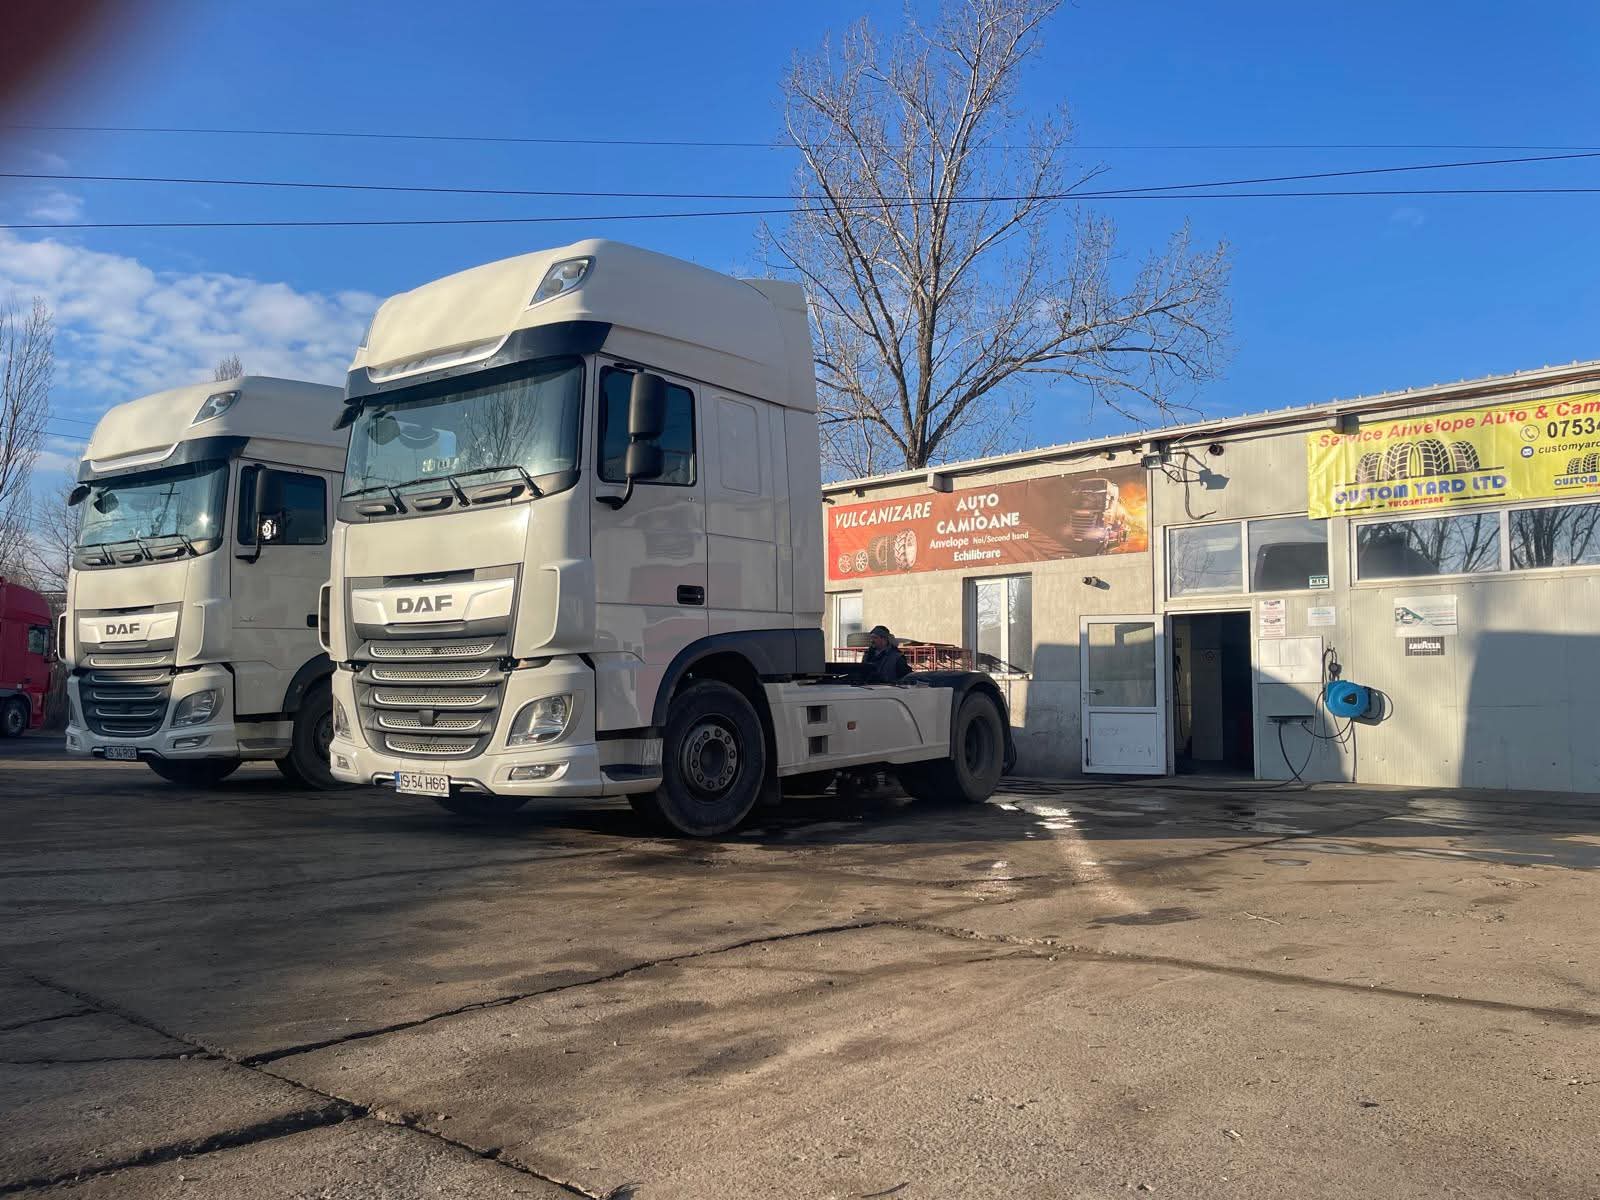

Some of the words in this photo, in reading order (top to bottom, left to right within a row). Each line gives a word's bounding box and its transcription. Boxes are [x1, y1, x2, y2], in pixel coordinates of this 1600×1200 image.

[1388, 417, 1475, 438] Anvelope
[1481, 409, 1527, 426] Auto
[1535, 405, 1548, 419] &
[1414, 479, 1466, 495] YARD
[1472, 475, 1508, 490] LTD
[956, 493, 999, 512] AUTO
[834, 501, 932, 529] VULCANIZARE
[936, 512, 1020, 534] CAMIOANE
[929, 536, 969, 549] Anvelope
[1012, 531, 1029, 541] hand
[953, 549, 1001, 562] Echilibrare
[396, 594, 453, 614] DAF
[105, 622, 140, 635] DAF
[411, 775, 423, 789] 54
